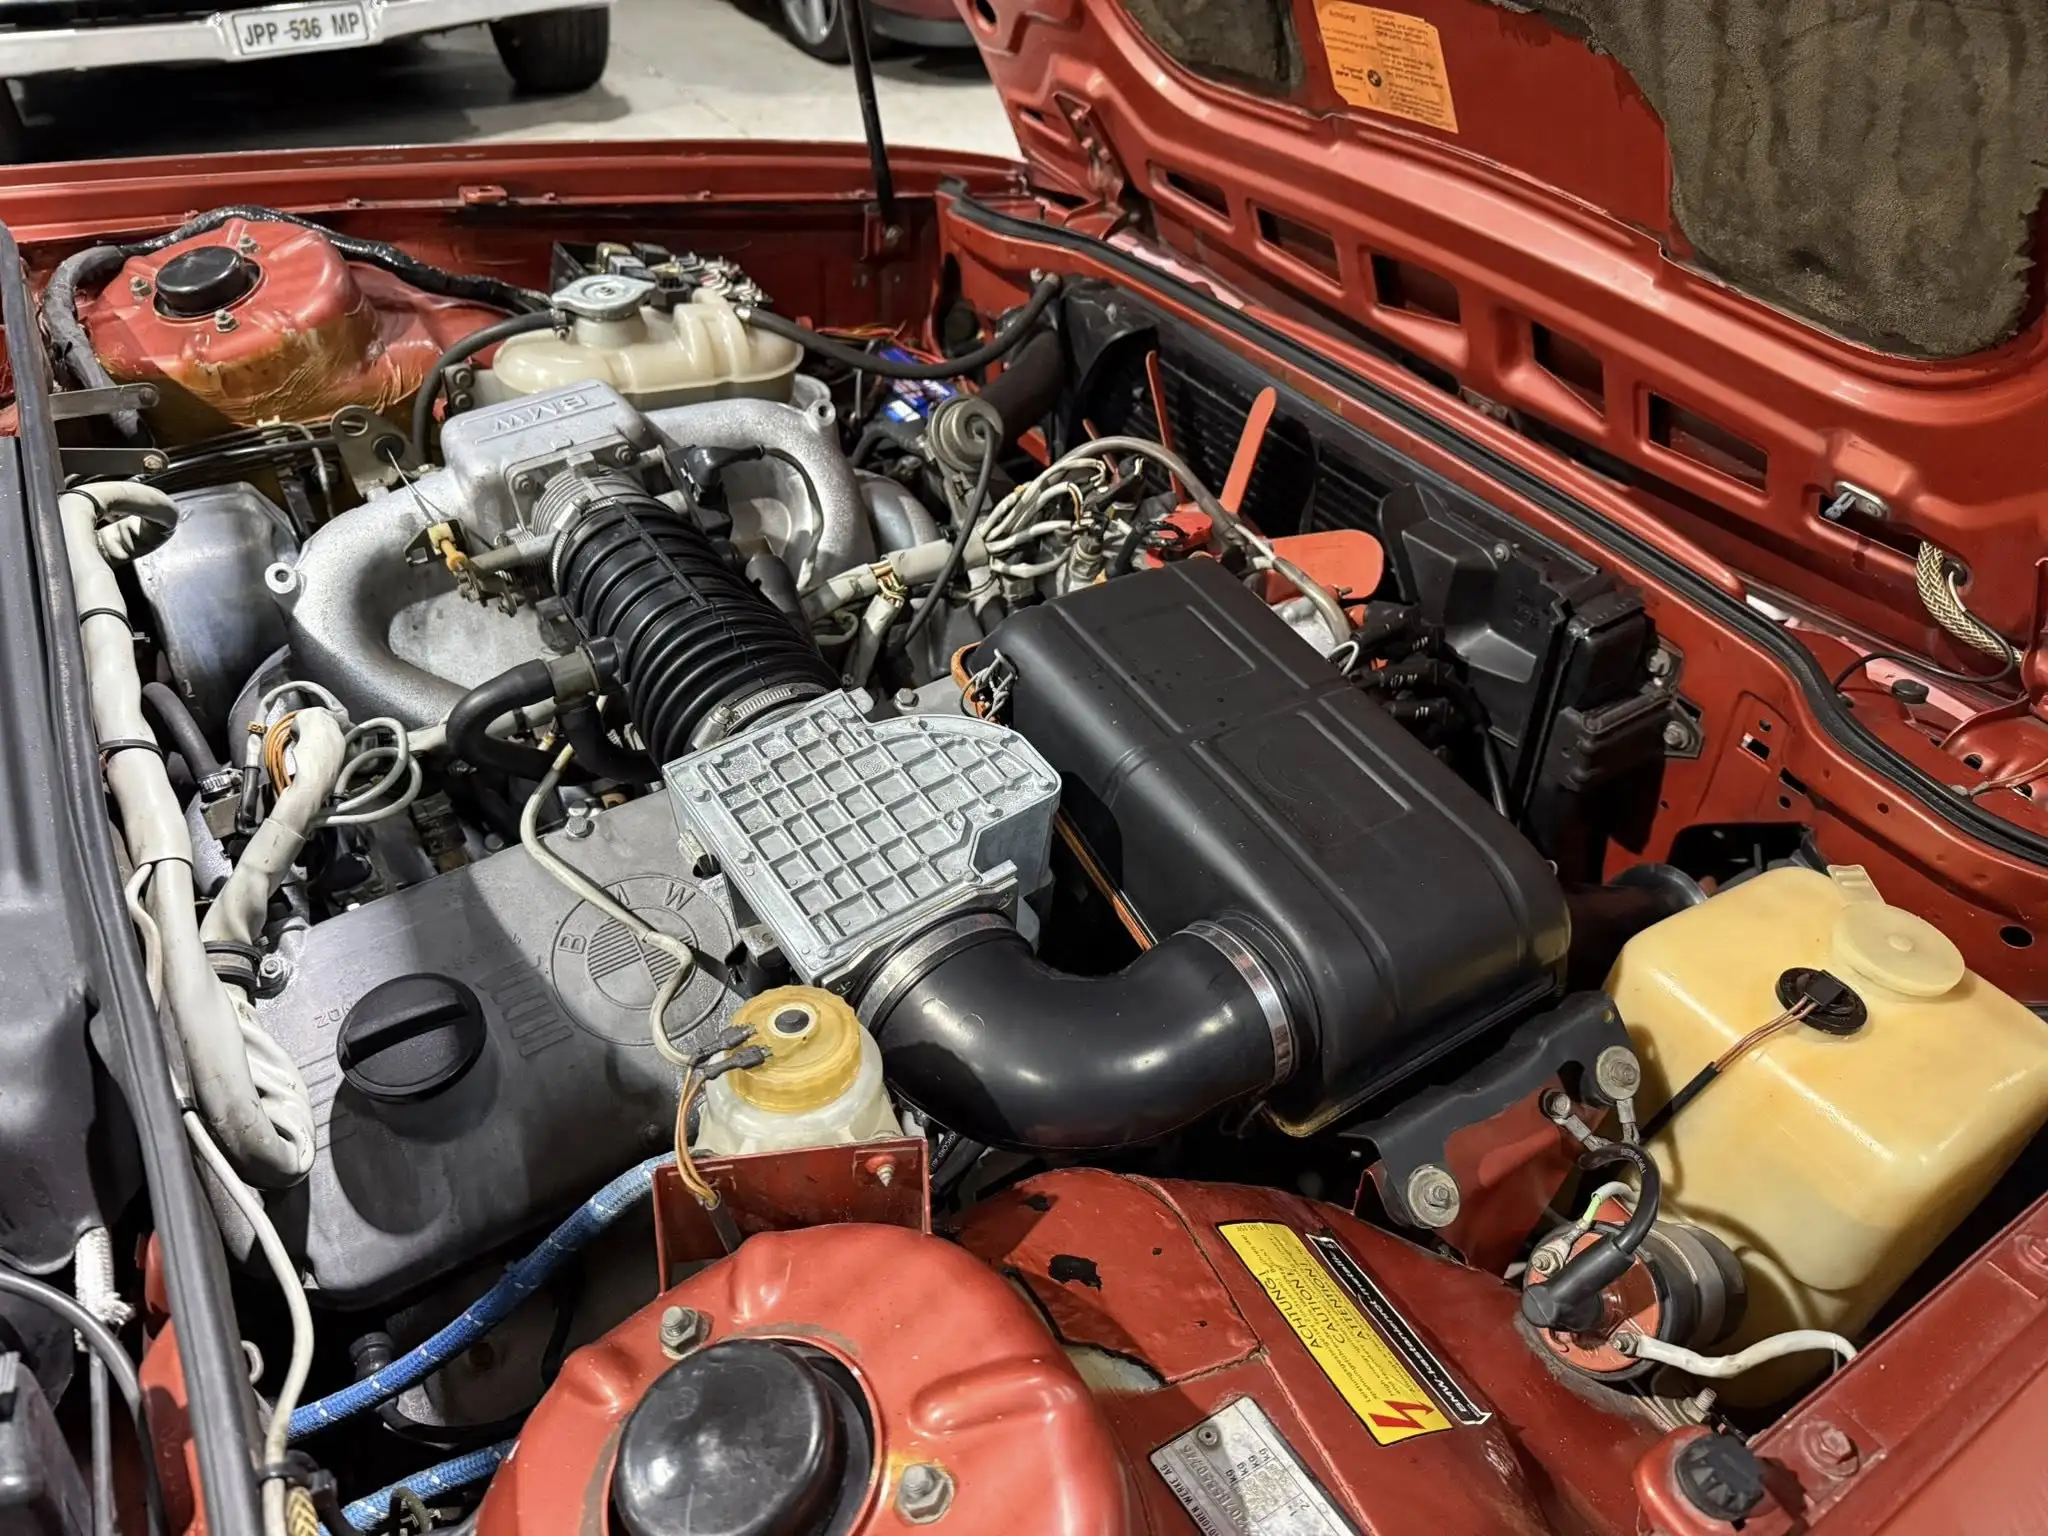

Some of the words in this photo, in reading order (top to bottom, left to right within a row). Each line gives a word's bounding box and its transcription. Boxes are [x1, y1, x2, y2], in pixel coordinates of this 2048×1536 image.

[245, 22, 278, 46] JPP
[289, 18, 322, 41] 536
[332, 12, 359, 35] MP
[492, 394, 588, 432] BMW
[1248, 1454, 1260, 1469] kg
[1258, 1447, 1271, 1462] kg
[1159, 1463, 1173, 1477] AG
[1225, 1469, 1239, 1485] kg
[1236, 1461, 1249, 1477] kg
[1172, 1477, 1193, 1505] WERKE
